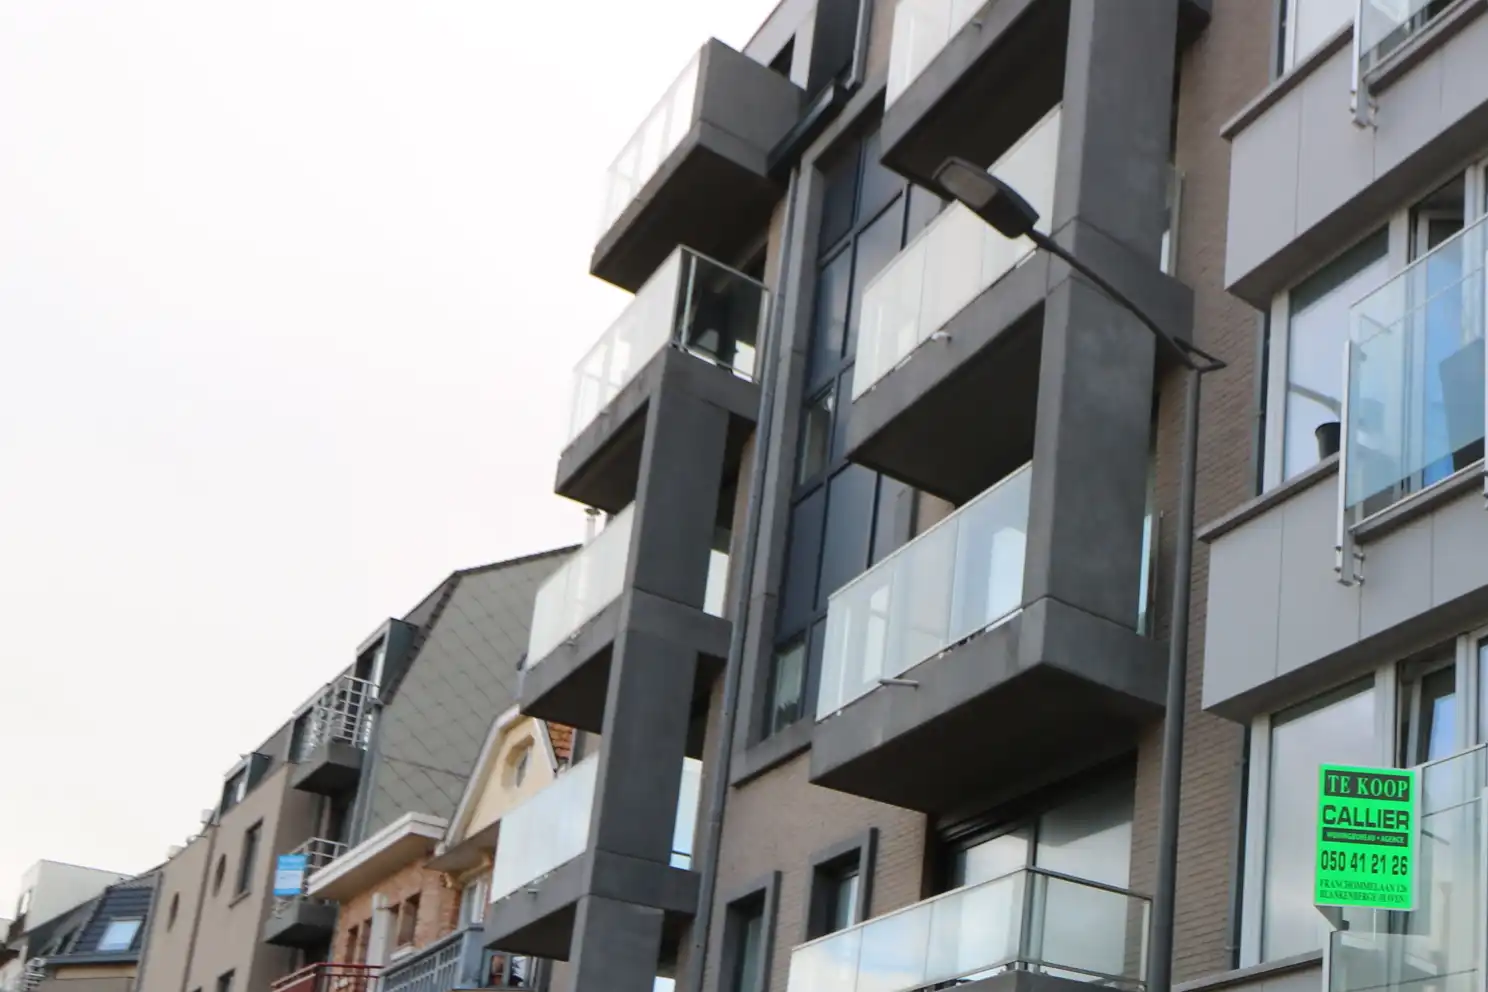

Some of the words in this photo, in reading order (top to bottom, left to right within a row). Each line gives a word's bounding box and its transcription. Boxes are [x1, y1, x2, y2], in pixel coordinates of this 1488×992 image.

[1327, 774, 1351, 794] TE
[1357, 776, 1409, 798] KOOP
[1322, 804, 1410, 830] CALLIER
[1321, 850, 1346, 871] 050
[1350, 852, 1366, 873] 41
[1371, 853, 1386, 875] 21
[1391, 855, 1408, 876] 26
